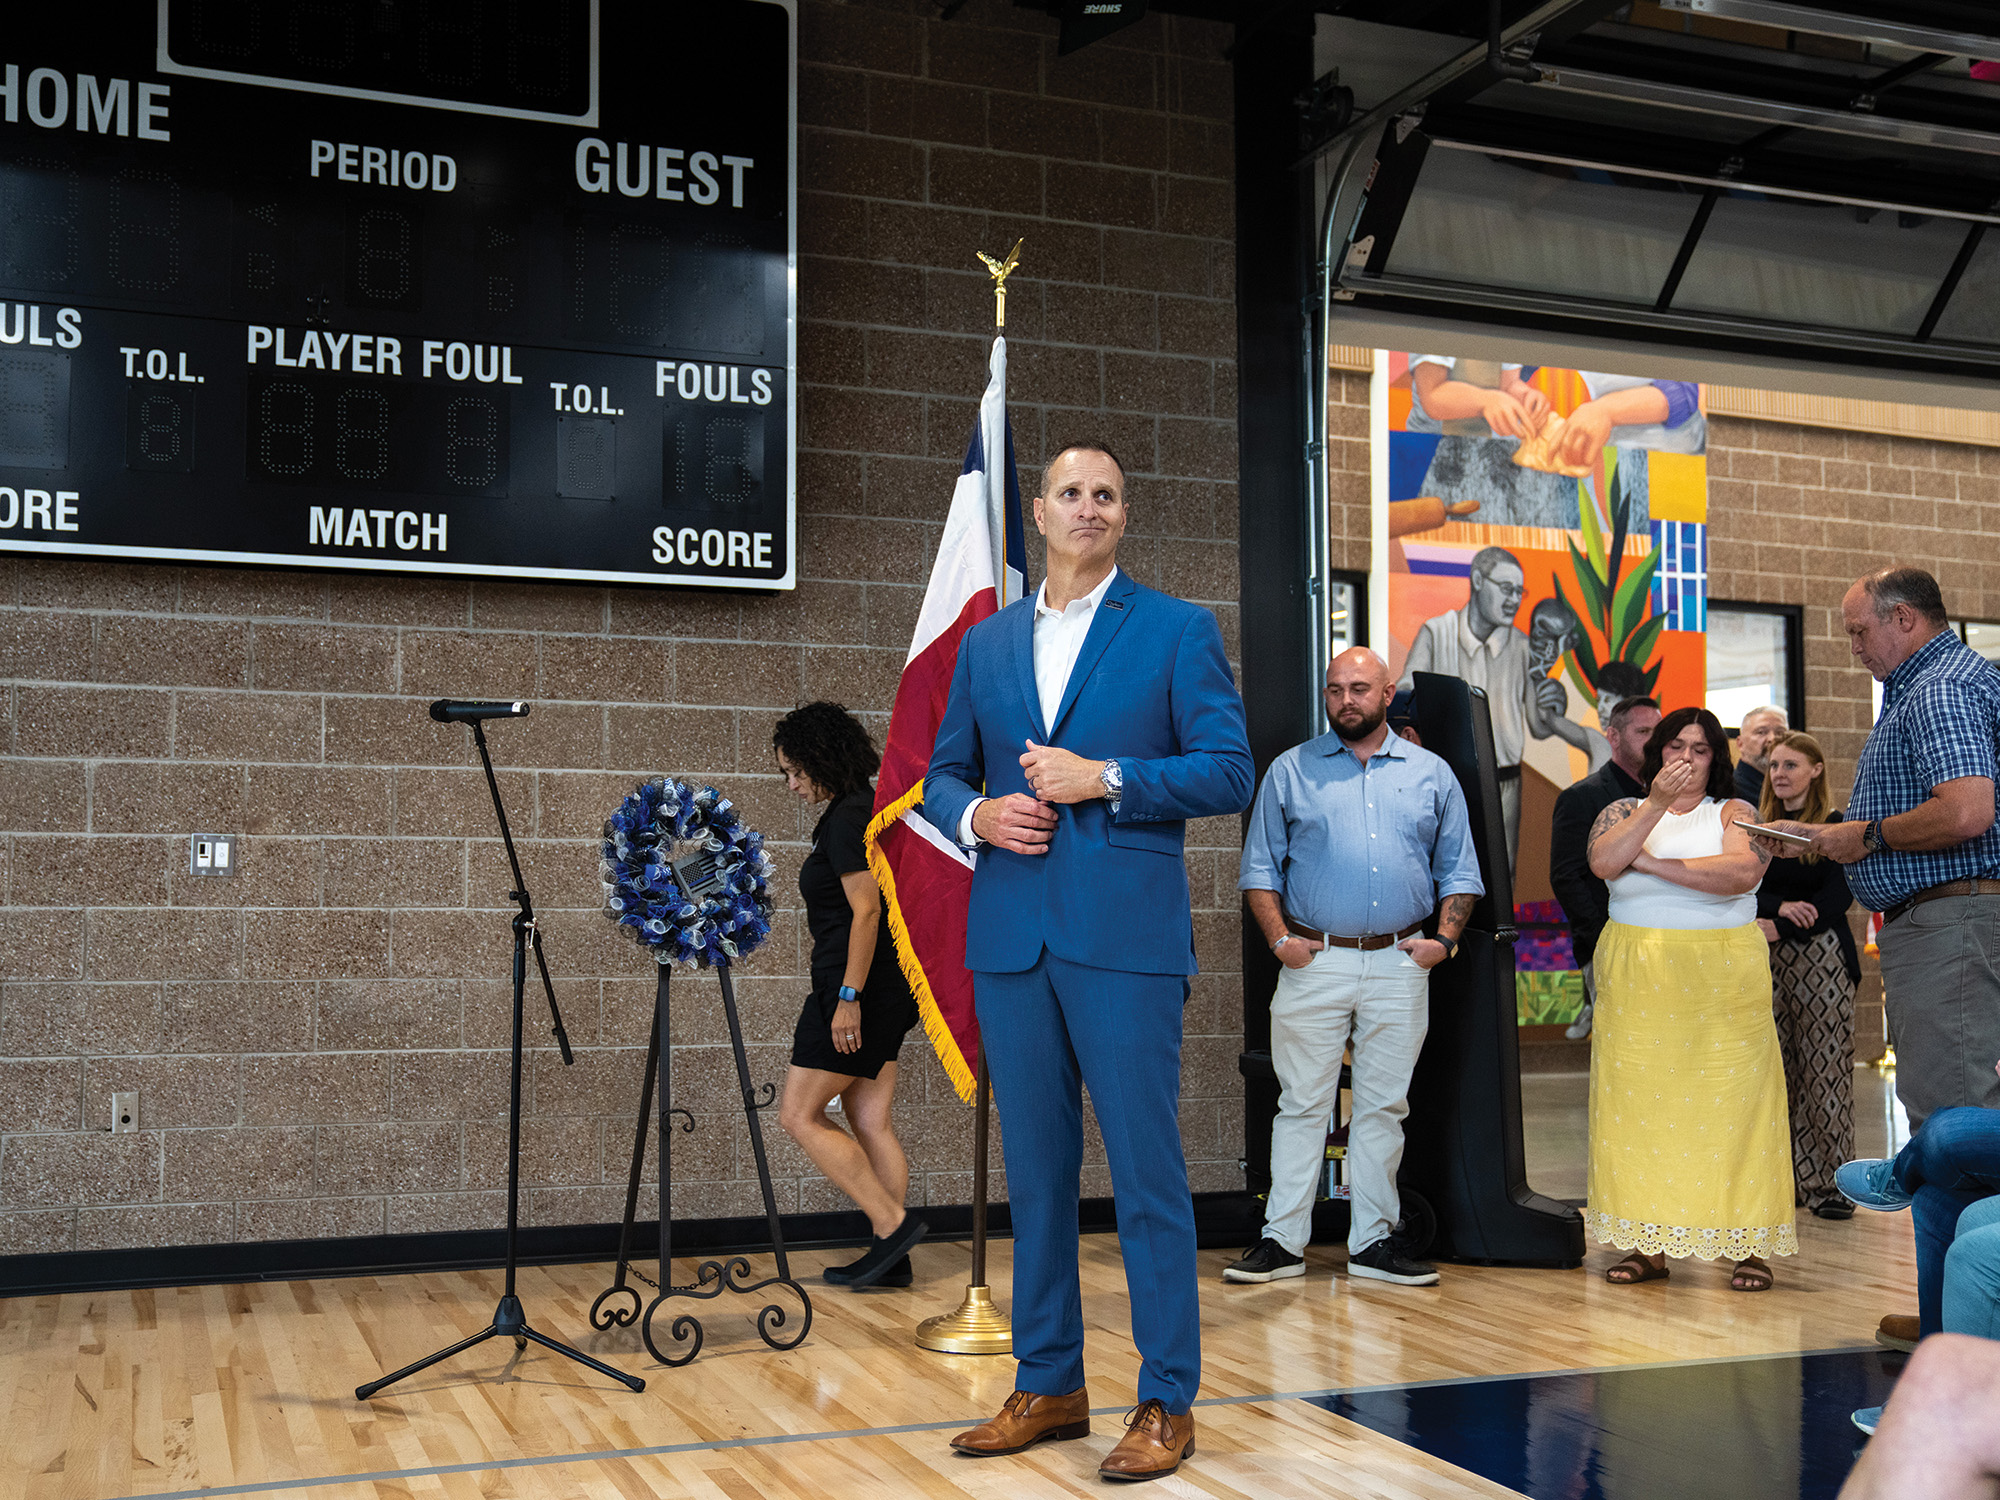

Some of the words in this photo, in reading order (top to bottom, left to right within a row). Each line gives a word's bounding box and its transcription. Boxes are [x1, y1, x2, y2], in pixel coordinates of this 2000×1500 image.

[1083, 4, 1123, 14] SHURE
[310, 139, 458, 193] PERIOD
[575, 137, 755, 209] GUEST
[120, 347, 205, 384] T.O.L.
[247, 325, 402, 376] PLAYER
[422, 340, 523, 385] FOUL
[550, 382, 624, 416] T.O.L.
[656, 360, 772, 406] FOULS
[309, 505, 448, 552] MATCH
[651, 526, 773, 569] SCORE
